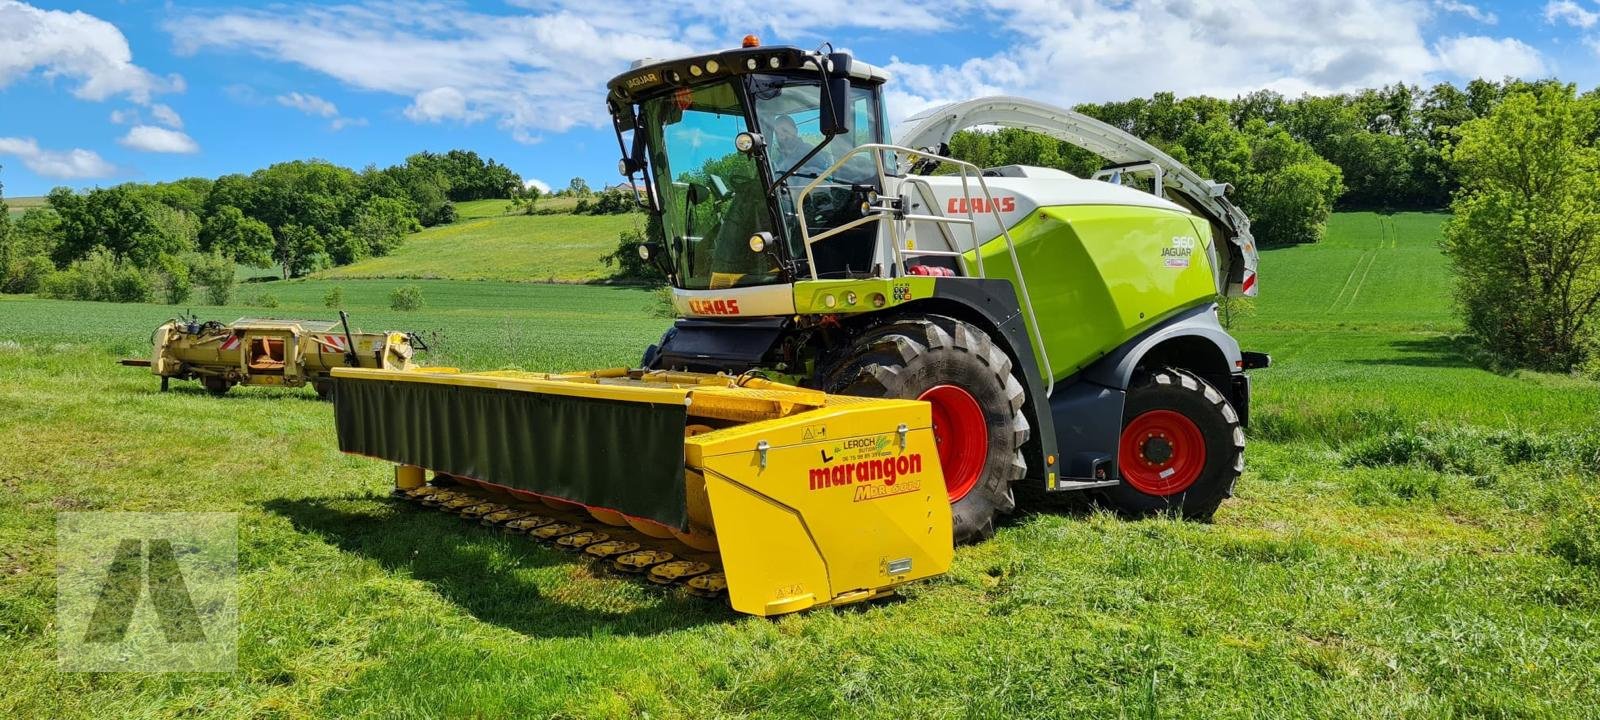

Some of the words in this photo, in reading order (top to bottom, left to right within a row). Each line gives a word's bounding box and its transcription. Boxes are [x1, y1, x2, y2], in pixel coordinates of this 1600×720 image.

[947, 197, 1016, 214] CLAAS
[1172, 236, 1195, 249] 960
[1161, 247, 1192, 257] JAGUAR
[688, 299, 740, 315] CLAAS
[809, 453, 922, 491] marangon
